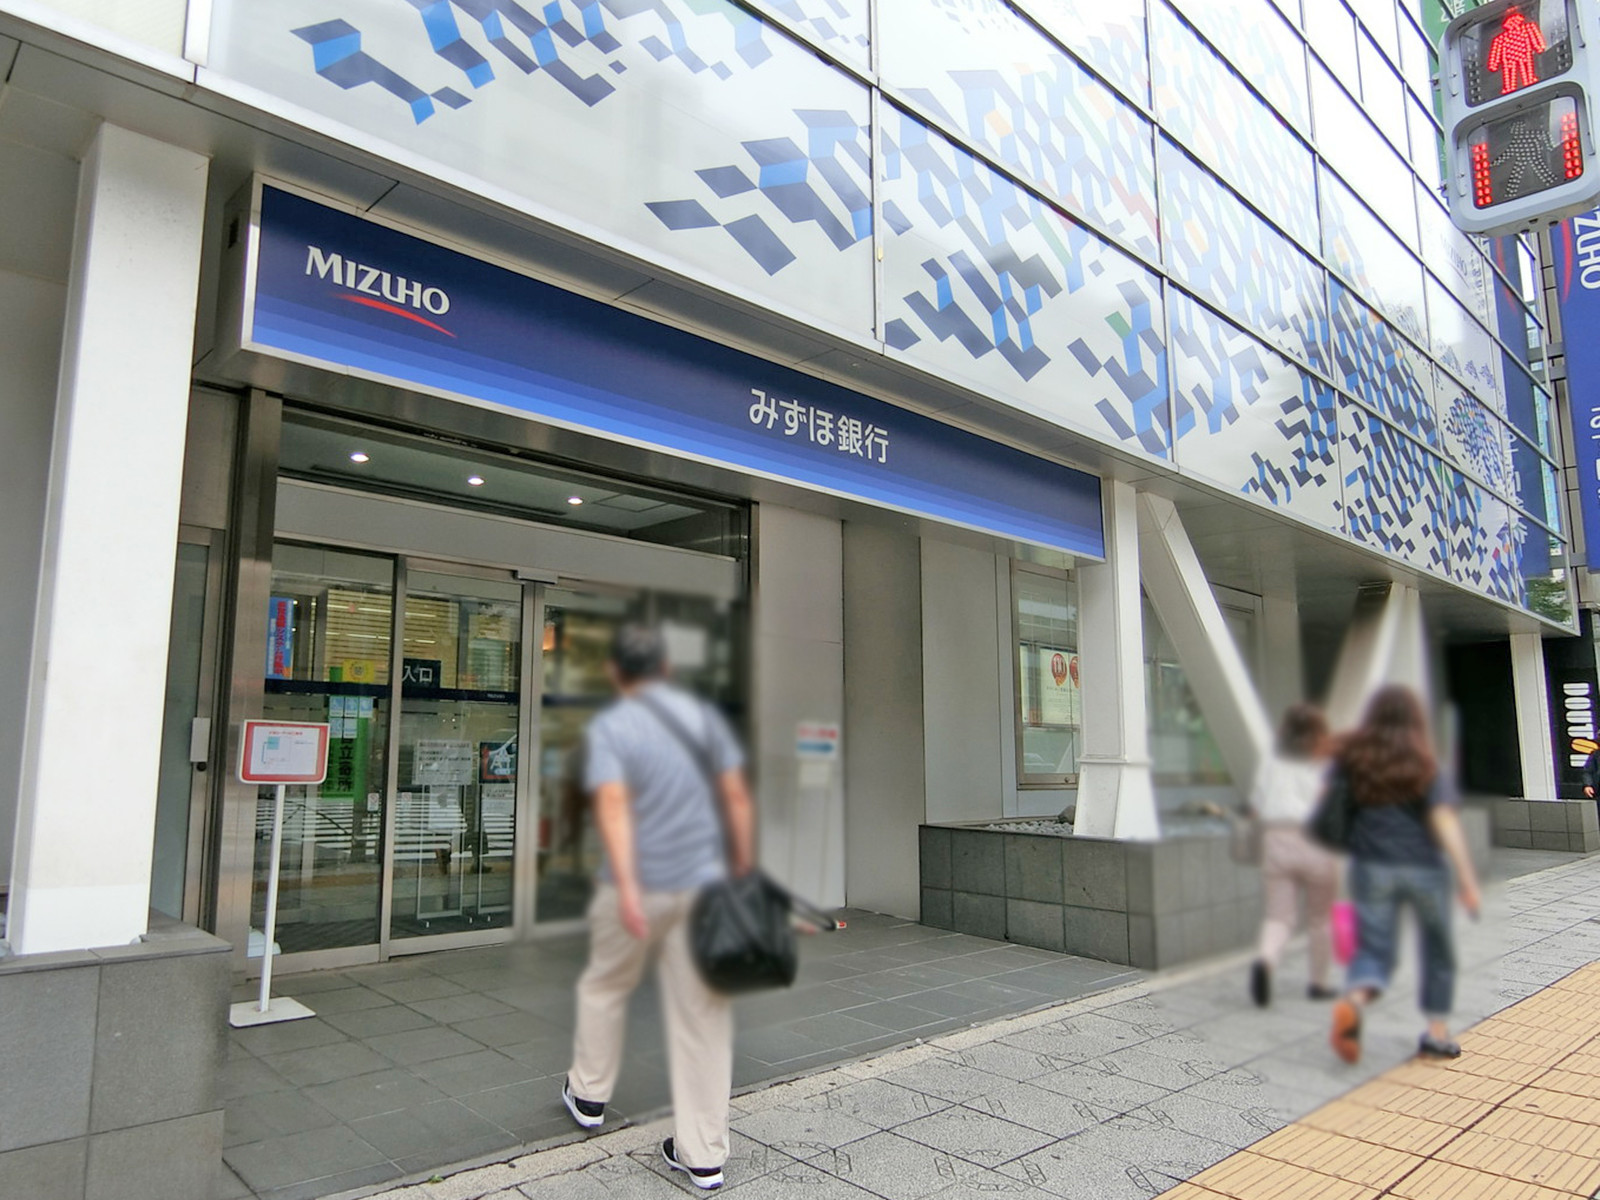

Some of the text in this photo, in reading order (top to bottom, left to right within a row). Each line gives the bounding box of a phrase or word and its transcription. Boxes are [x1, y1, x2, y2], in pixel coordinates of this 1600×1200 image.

[305, 245, 450, 315] MIZUHO
[1573, 205, 1600, 289] ZUHO
[749, 388, 889, 464] みずほ銀行
[402, 665, 433, 683] 入口
